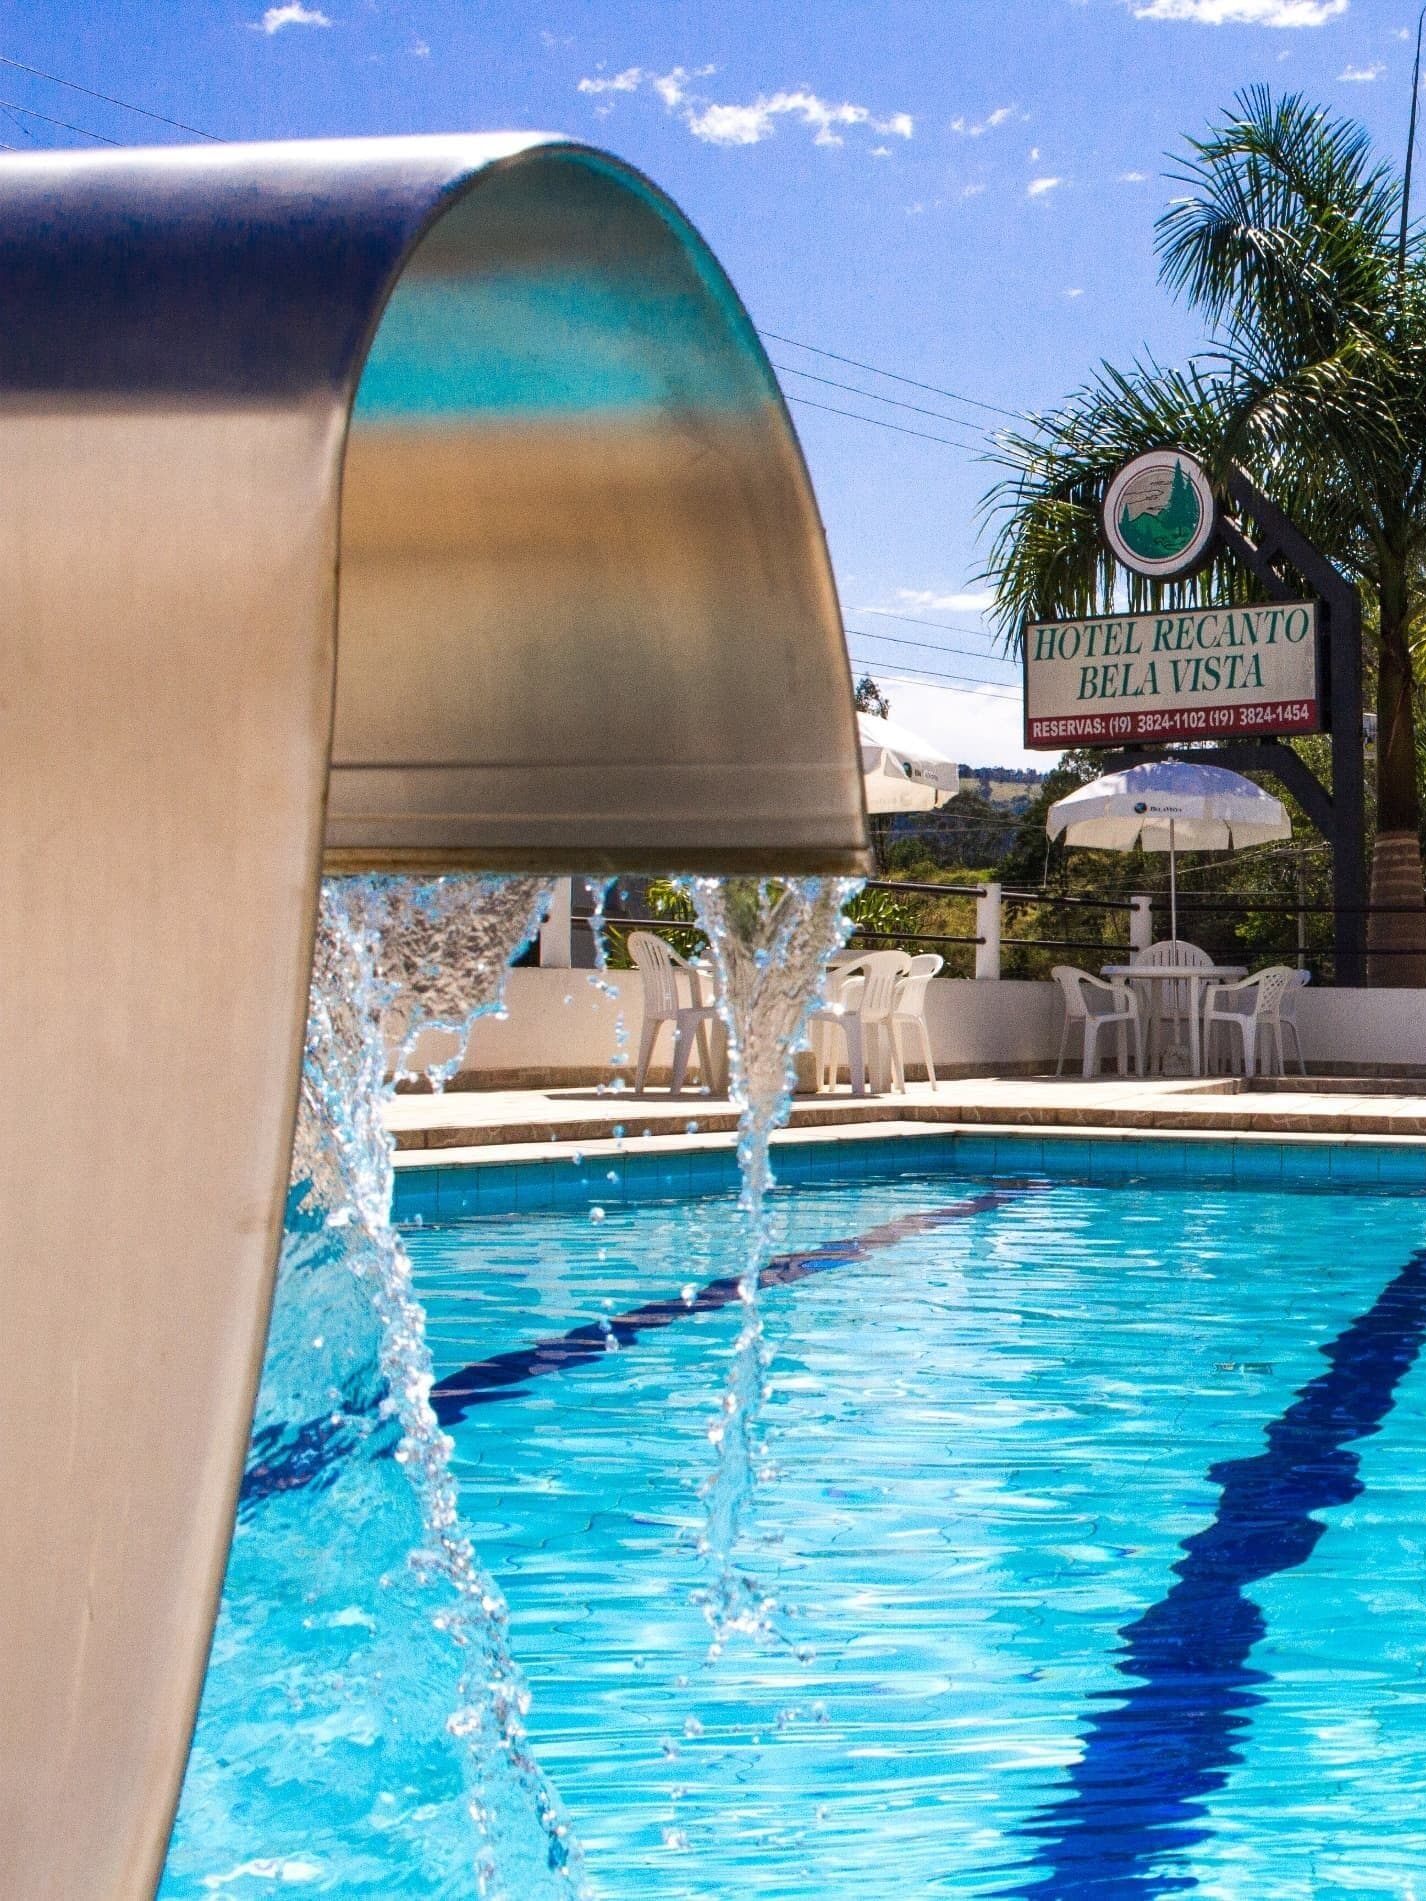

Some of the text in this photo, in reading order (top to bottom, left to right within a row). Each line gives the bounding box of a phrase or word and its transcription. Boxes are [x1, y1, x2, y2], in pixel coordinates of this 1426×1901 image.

[1033, 608, 1310, 661] HOTEL RECANTO
[1077, 652, 1265, 700] BELA VISTA
[1033, 703, 1310, 738] RESERVAS: (19) 3824-1102 (19) 3824-1454
